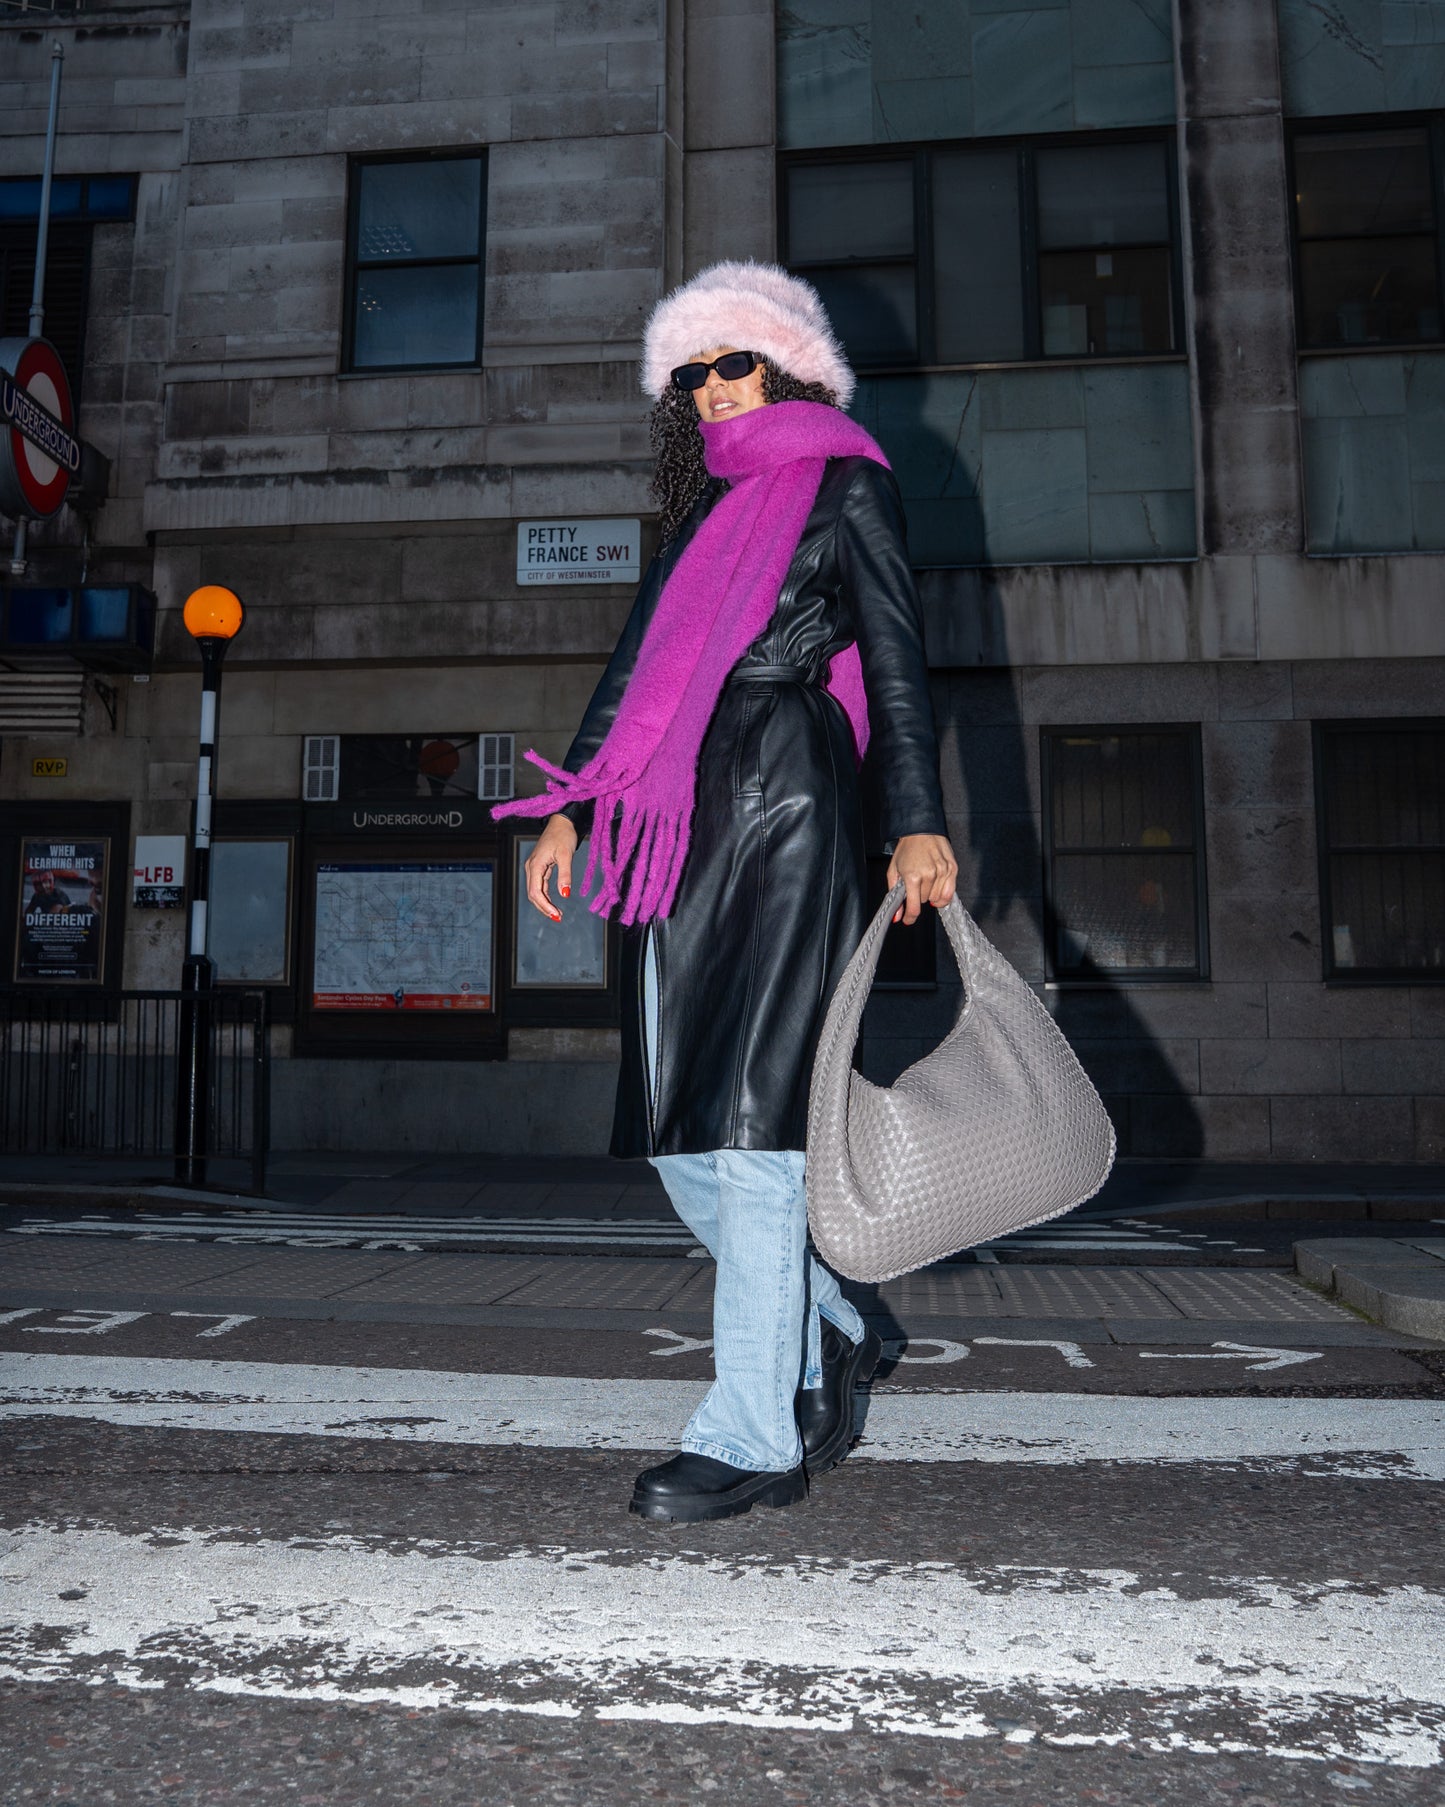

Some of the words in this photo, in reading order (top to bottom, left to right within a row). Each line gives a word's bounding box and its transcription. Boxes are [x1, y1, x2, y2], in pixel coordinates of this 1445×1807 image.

[4, 380, 80, 471] UNDERGROUND
[528, 527, 578, 544] PETTY
[528, 546, 588, 563] FRANCE
[596, 545, 630, 561] SW1
[527, 572, 543, 580] CITY
[558, 570, 611, 579] WESTMINSTER
[36, 761, 64, 773] RVP
[353, 811, 463, 828] UNDERGROUND
[49, 845, 76, 857] WHEN
[29, 857, 73, 869] LEARNING
[74, 857, 95, 869] HITS
[144, 866, 173, 883] LFB
[26, 913, 94, 927] DIFFERENT
